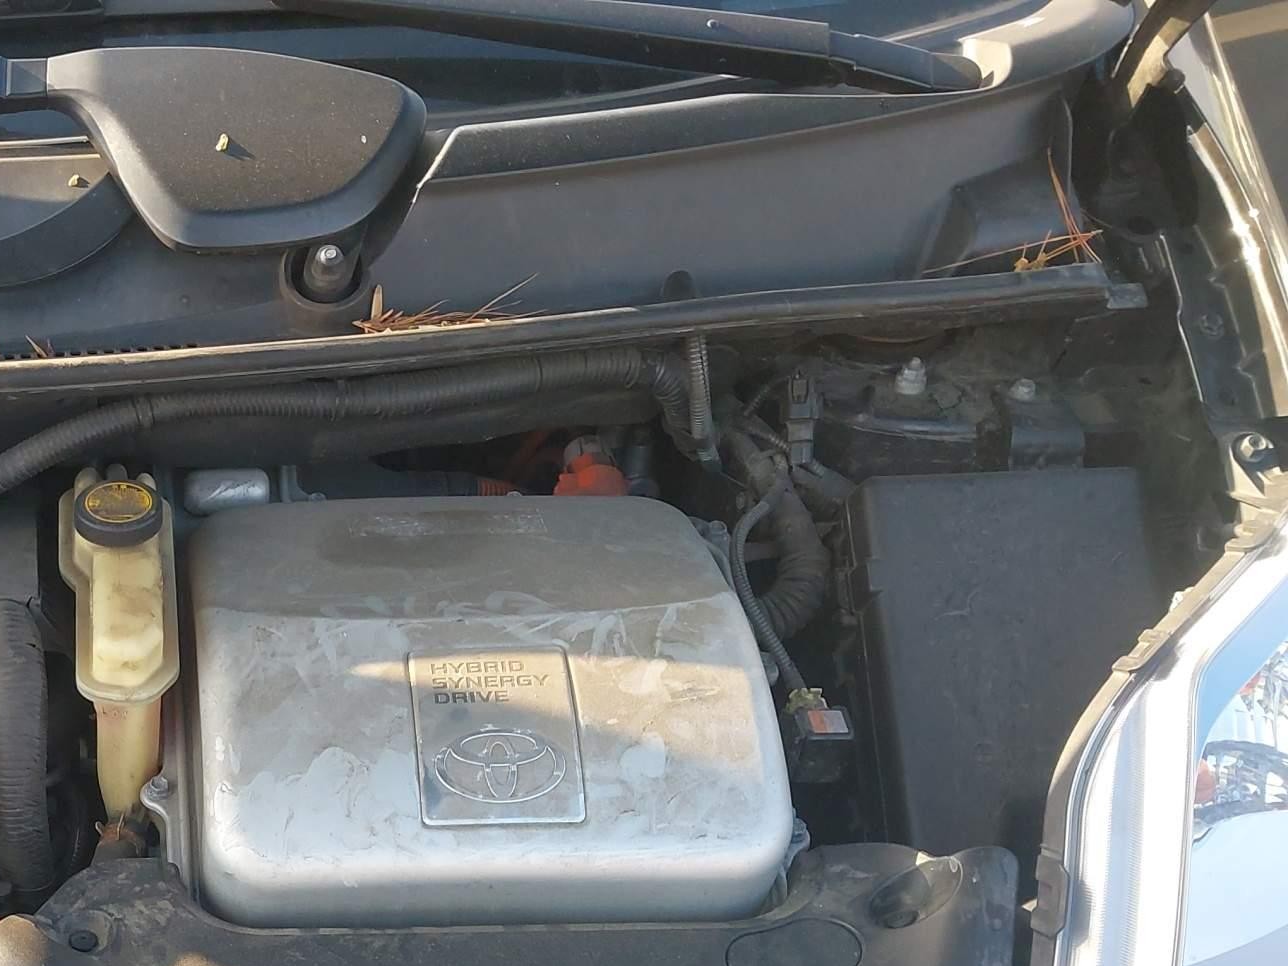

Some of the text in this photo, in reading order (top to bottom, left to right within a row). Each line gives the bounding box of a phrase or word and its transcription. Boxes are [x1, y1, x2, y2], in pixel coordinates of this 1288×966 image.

[431, 661, 524, 674] HYBRID
[431, 674, 549, 690] SYNERGY
[434, 690, 510, 705] DRIVE
